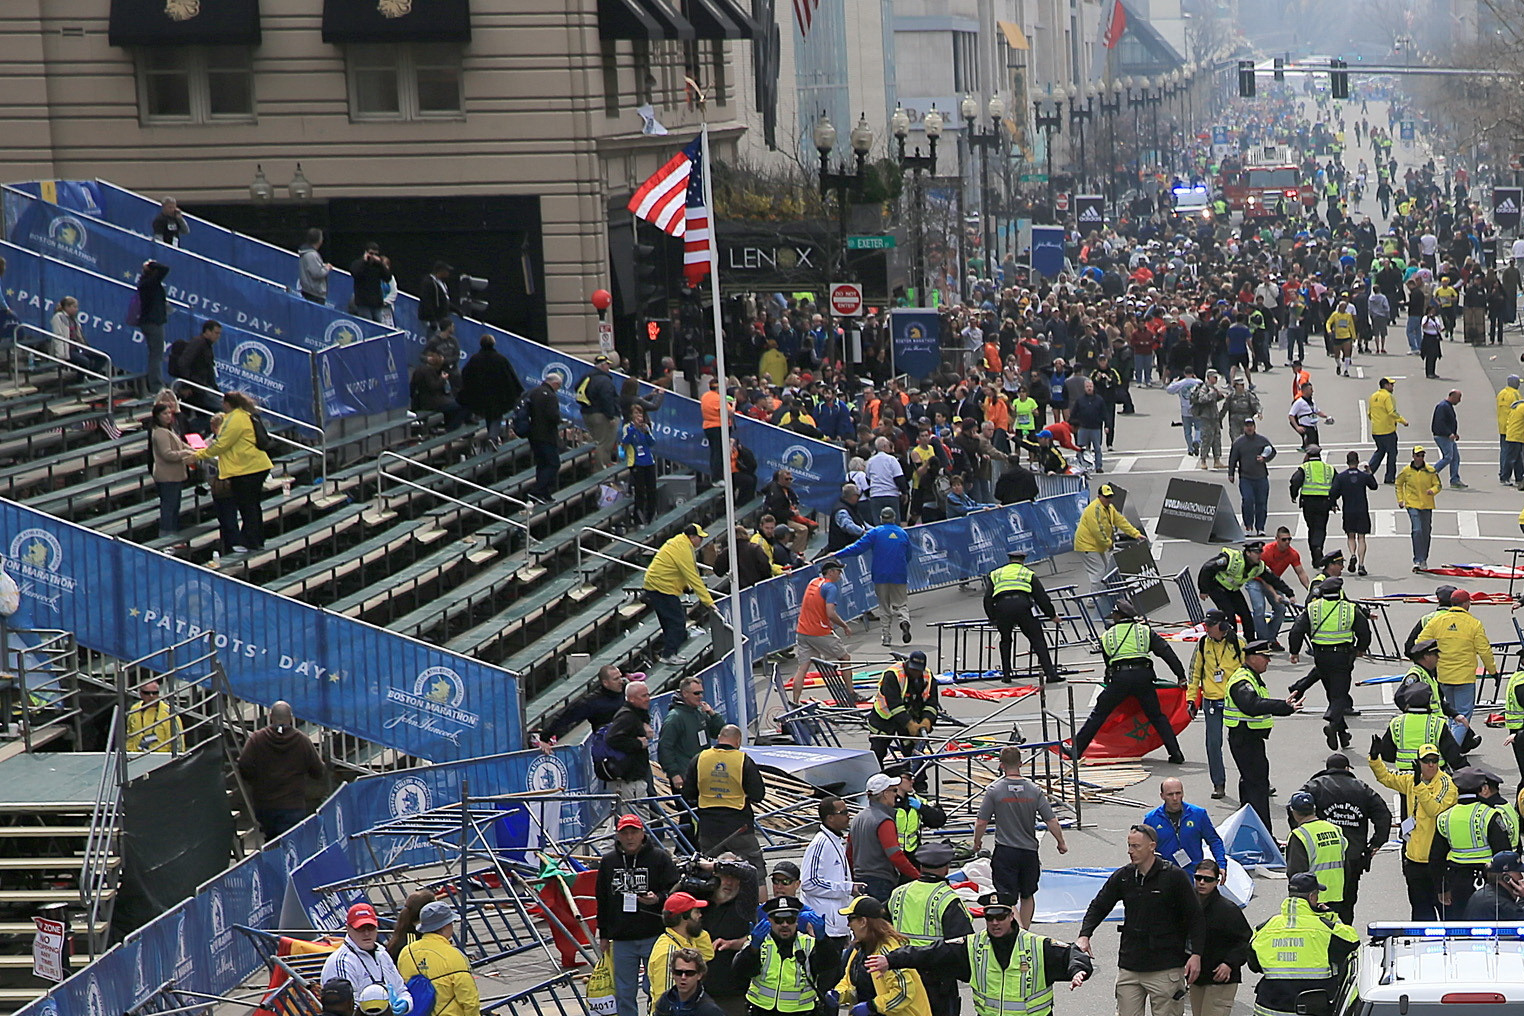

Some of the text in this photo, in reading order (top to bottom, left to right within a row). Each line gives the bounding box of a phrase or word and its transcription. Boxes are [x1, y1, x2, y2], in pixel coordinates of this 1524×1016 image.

[907, 108, 950, 123] BAK
[857, 238, 884, 249] EXETER
[236, 310, 274, 332] DAY
[21, 566, 77, 590] MARATHON
[143, 609, 326, 680] PATRIOTS' DAY
[387, 689, 477, 726] BOSTON MARATHON
[383, 707, 464, 747] John Hancock
[1322, 803, 1364, 819] Boston Police
[1332, 811, 1356, 821] Special
[1316, 831, 1338, 843] BOSTON
[43, 923, 63, 936] ZONE
[39, 935, 51, 945] NO
[1271, 937, 1306, 949] BOSTON
[35, 942, 60, 955] STOPPING
[41, 950, 52, 958] ANY
[41, 956, 54, 967] TIME
[1276, 951, 1299, 963] FIRE
[1025, 948, 1033, 990] POLICE
